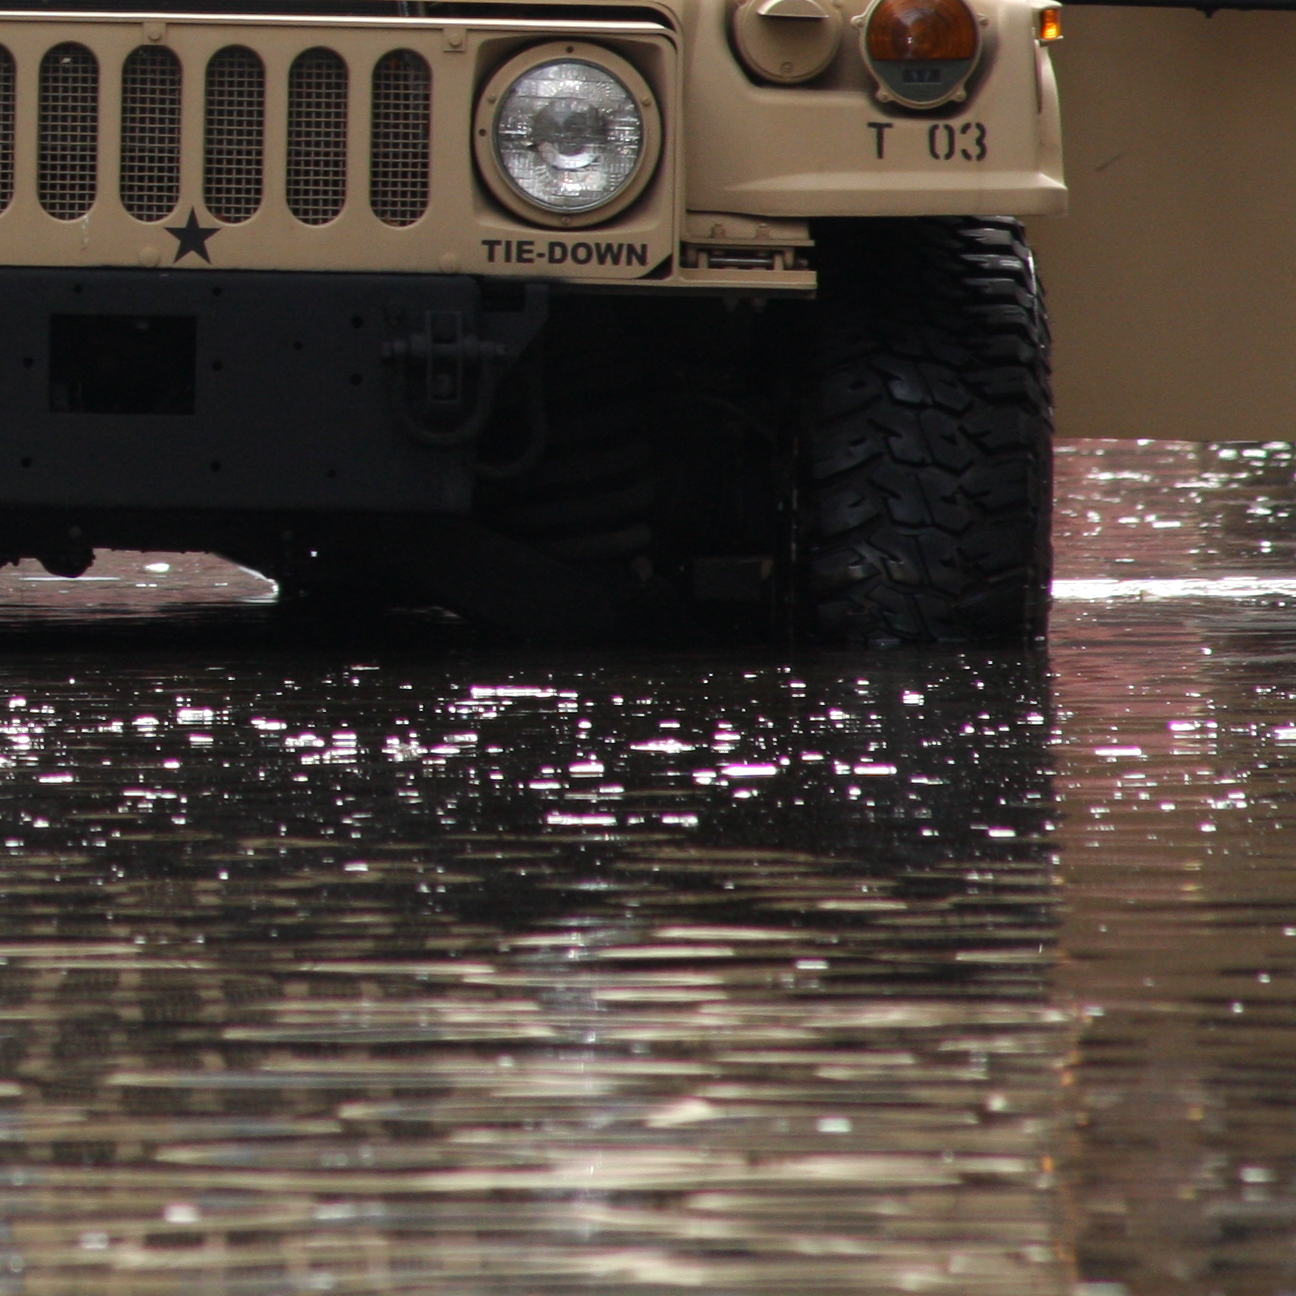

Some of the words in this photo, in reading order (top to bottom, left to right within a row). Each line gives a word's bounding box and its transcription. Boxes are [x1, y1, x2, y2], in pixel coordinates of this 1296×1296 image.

[867, 122, 893, 159] T
[928, 122, 987, 161] 03
[481, 240, 648, 266] TIE-DOWN
